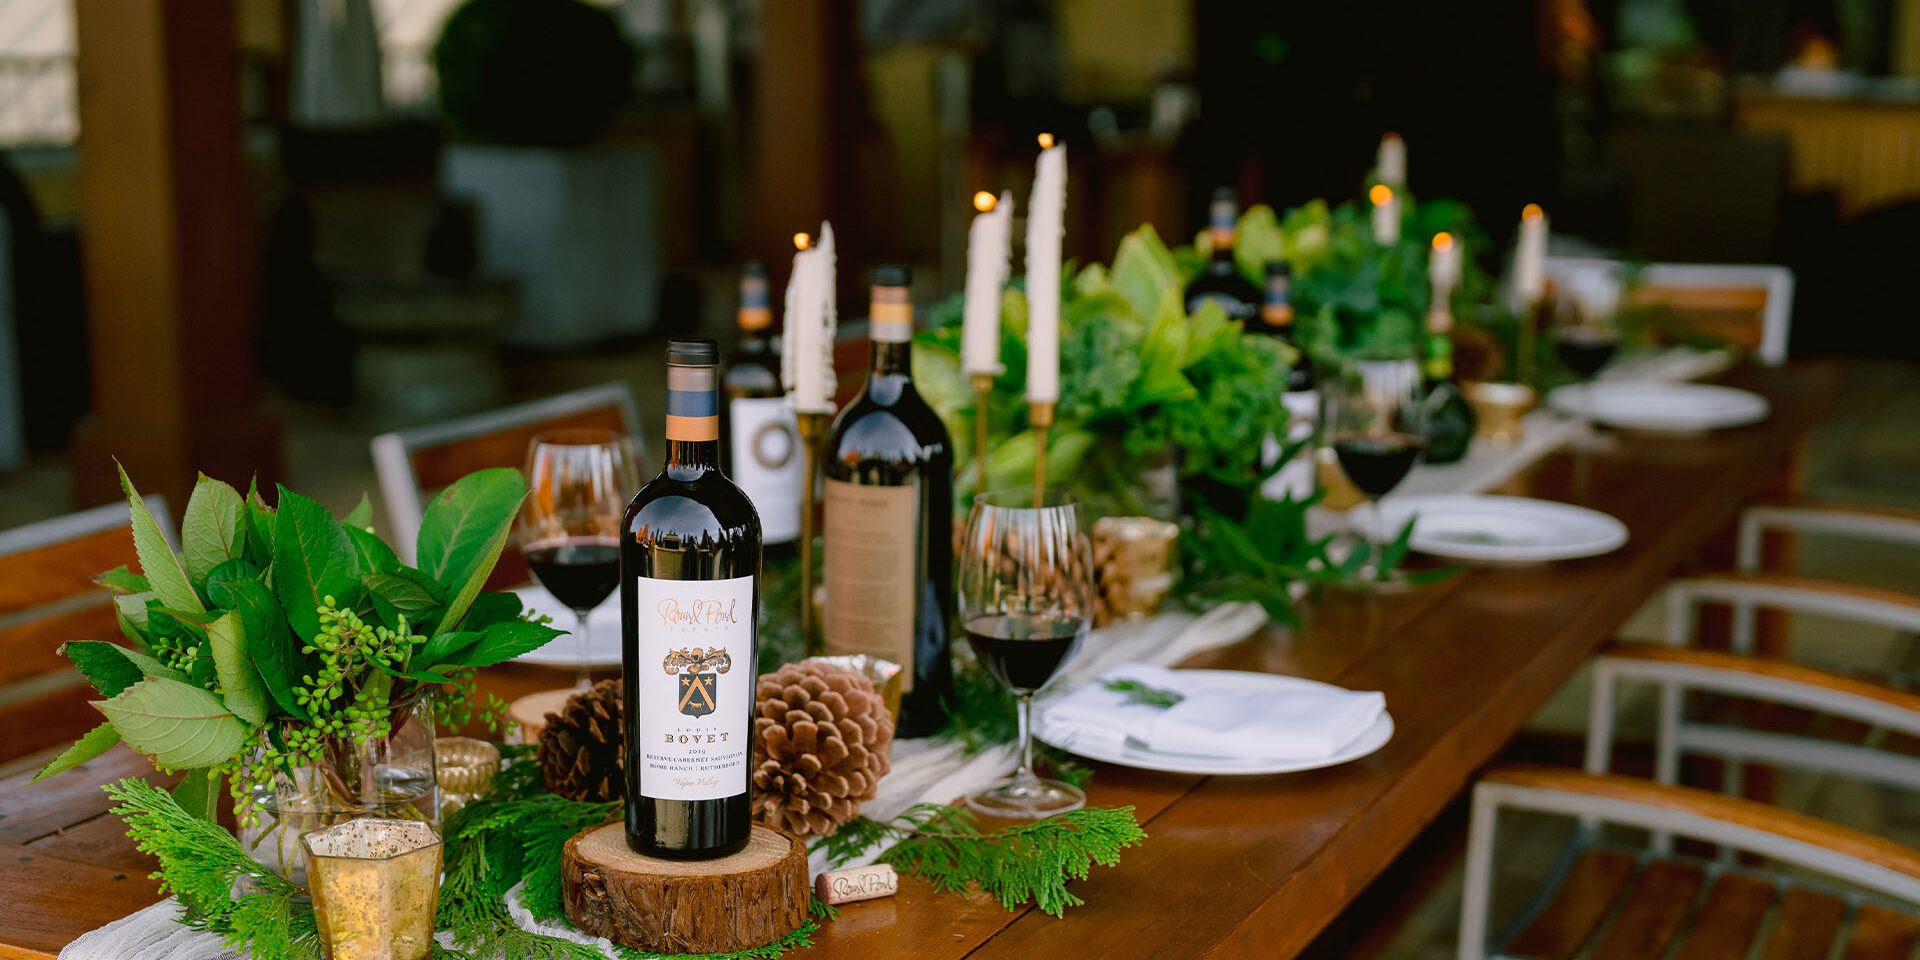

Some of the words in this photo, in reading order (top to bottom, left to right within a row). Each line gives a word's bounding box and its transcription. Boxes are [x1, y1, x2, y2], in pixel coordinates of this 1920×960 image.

[656, 598, 703, 626] Round
[703, 598, 737, 625] Pond
[664, 732, 729, 744] BOVET
[646, 753, 672, 762] RESERVE
[711, 751, 743, 761] SAUVIGNON
[649, 763, 668, 771] HOME
[700, 761, 740, 771] RUTHERFORD
